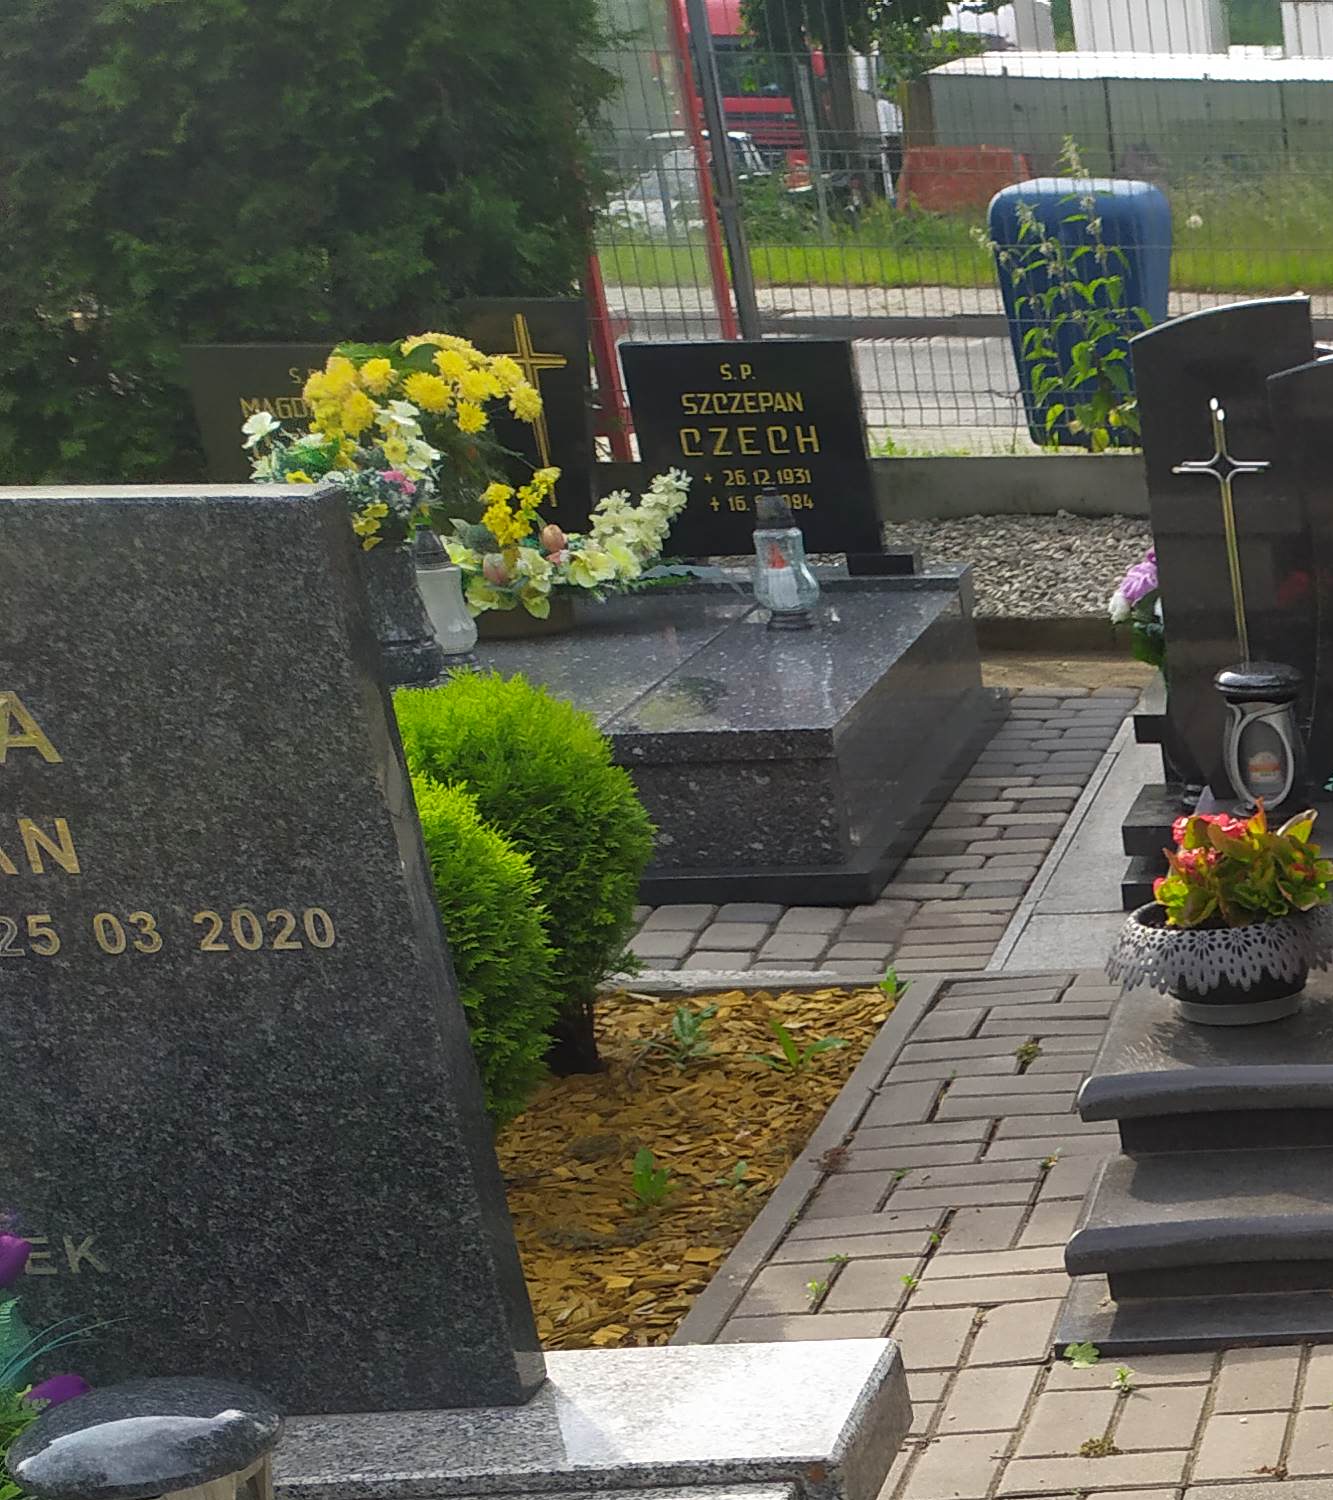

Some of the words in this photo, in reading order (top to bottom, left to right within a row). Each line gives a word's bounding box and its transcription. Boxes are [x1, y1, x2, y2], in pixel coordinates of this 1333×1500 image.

[240, 397, 312, 420] MAGD
[680, 391, 805, 415] SZCZEPAN
[679, 425, 821, 457] CZECH
[723, 468, 812, 487] 26.12.1931
[0, 817, 81, 875] N
[93, 911, 163, 955] 03
[193, 907, 336, 951] 2020
